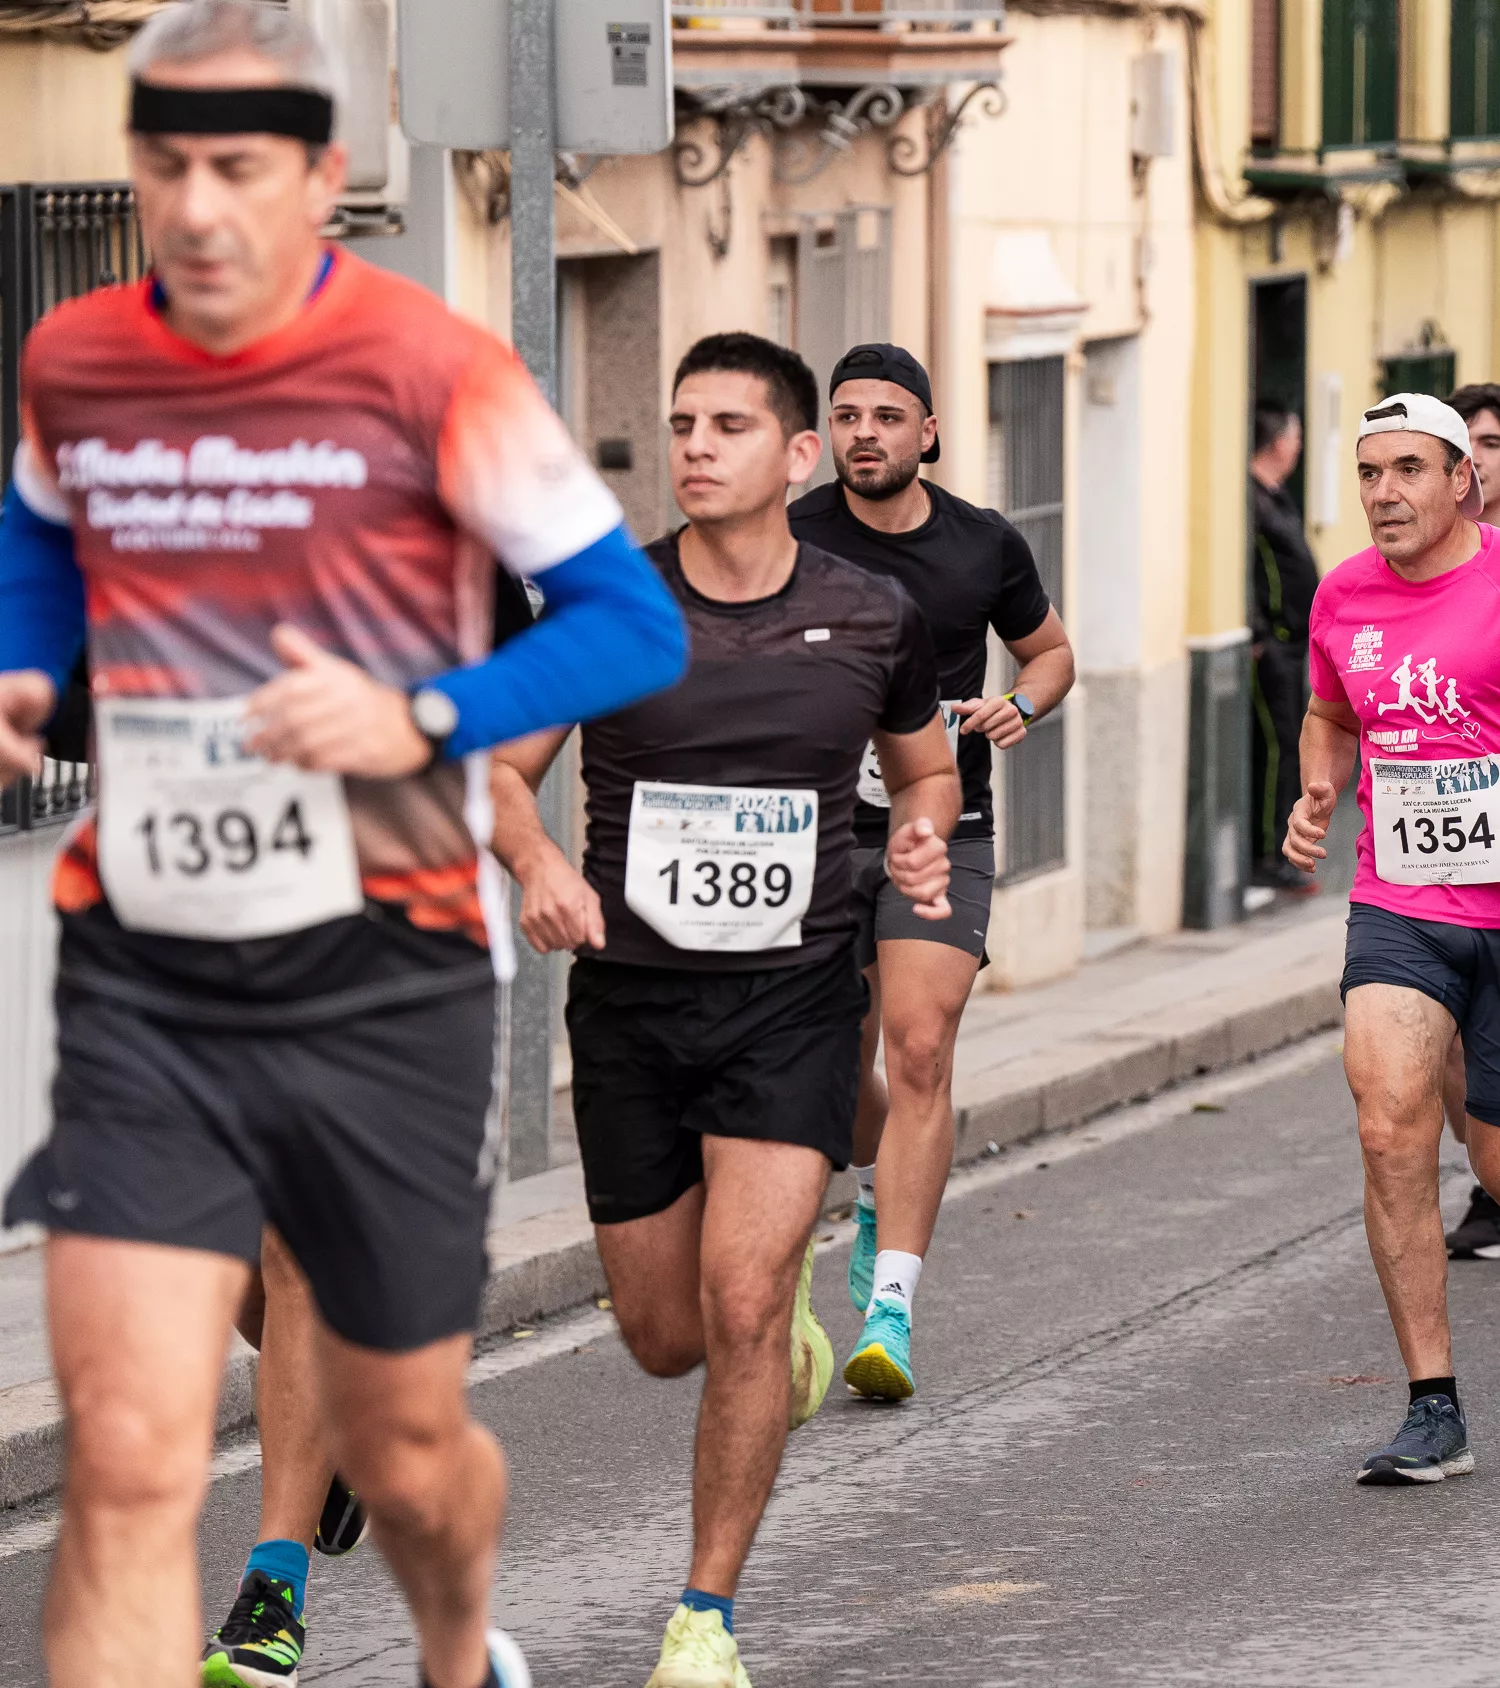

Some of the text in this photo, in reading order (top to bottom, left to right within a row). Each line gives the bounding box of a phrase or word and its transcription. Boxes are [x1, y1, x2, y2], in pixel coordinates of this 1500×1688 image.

[1353, 631, 1383, 644] CARRERA
[1351, 641, 1383, 650] POPULAR
[1348, 654, 1382, 664] LUCENA
[1400, 729, 1418, 744] KM
[1376, 770, 1401, 778] CARRERAS
[1396, 765, 1424, 773] PROVINCIAL
[1433, 762, 1470, 779] 2024
[736, 794, 783, 814] 2024
[135, 797, 312, 880] 1394
[1392, 811, 1496, 855] 1354
[658, 859, 793, 909] 1389
